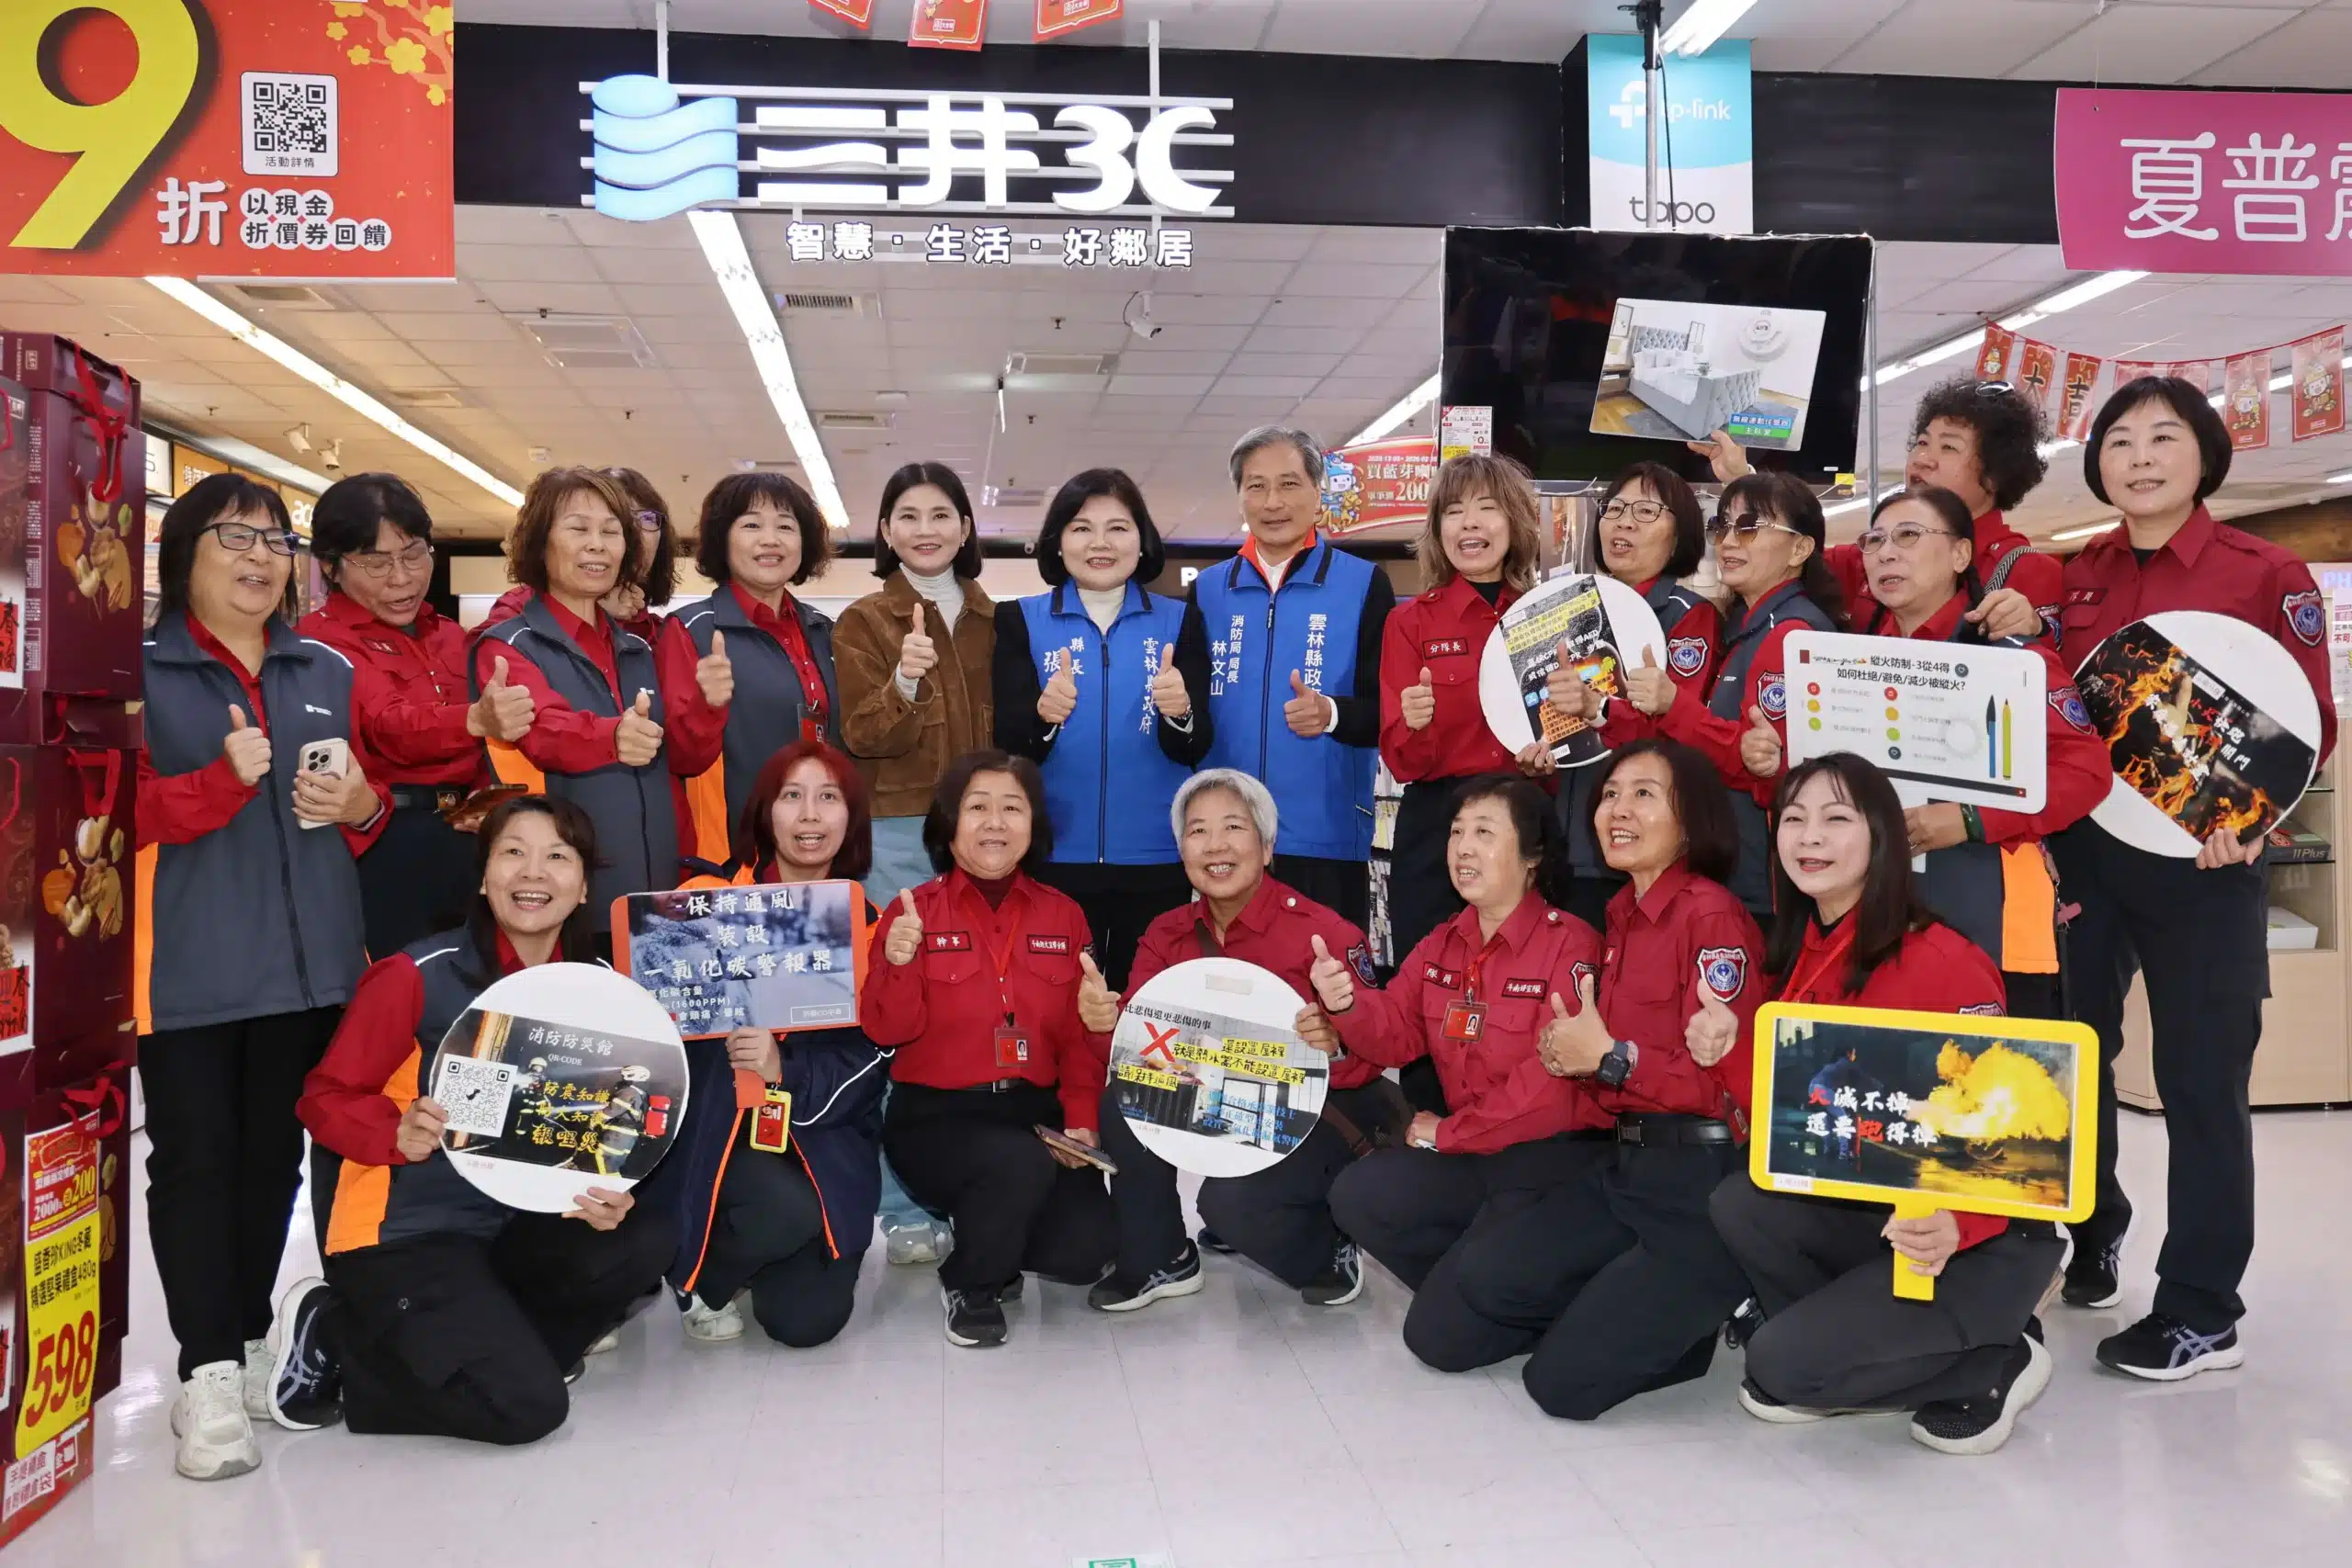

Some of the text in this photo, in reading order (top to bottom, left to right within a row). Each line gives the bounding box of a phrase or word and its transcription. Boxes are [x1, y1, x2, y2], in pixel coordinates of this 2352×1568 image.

[0, 0, 199, 249] 9
[265, 155, 315, 169] 活動詳情
[756, 94, 1223, 213] 三井3C
[157, 177, 229, 246] 折
[247, 194, 329, 217] 以現金
[245, 222, 388, 247] 折價券回饋
[2065, 375, 2090, 417] 吉
[1069, 637, 1085, 676] 縣長
[1226, 615, 1245, 683] 消防局局長
[1430, 641, 1462, 654] 分隊長
[1210, 639, 1227, 696] 林文山
[1871, 655, 1950, 673] 縱火防制-3從4得
[644, 950, 833, 982] 一氧化碳警報器
[1426, 967, 1453, 986] 隊員
[1125, 1003, 1213, 1031] 比悲傷還更悲傷的事
[528, 1026, 615, 1056] 消防防災館
[548, 1053, 583, 1066] QR-CODE
[544, 1079, 611, 1102] 防震知識
[1805, 1111, 1939, 1149] 還要跑得掉
[26, 1310, 95, 1427] 598
